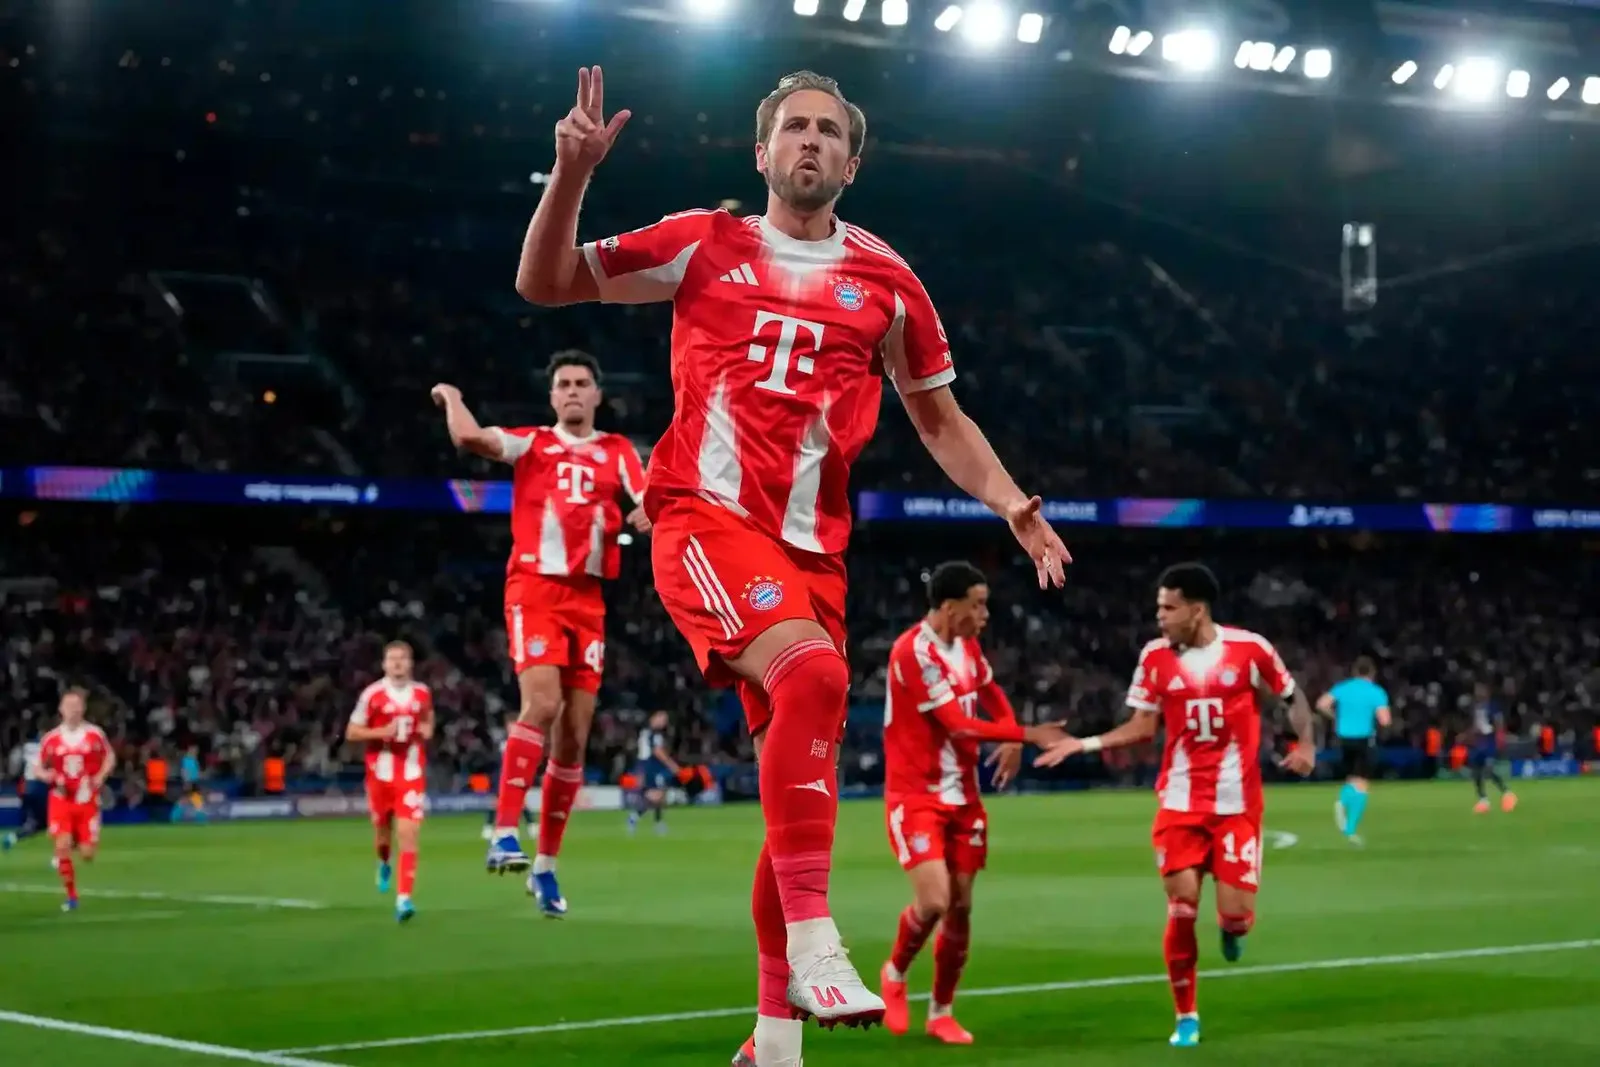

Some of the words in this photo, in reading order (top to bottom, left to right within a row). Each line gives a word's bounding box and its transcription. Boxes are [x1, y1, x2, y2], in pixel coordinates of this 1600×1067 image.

[747, 310, 825, 395] T
[557, 462, 595, 504] T
[1186, 698, 1223, 741] T
[1222, 832, 1258, 885] 14
